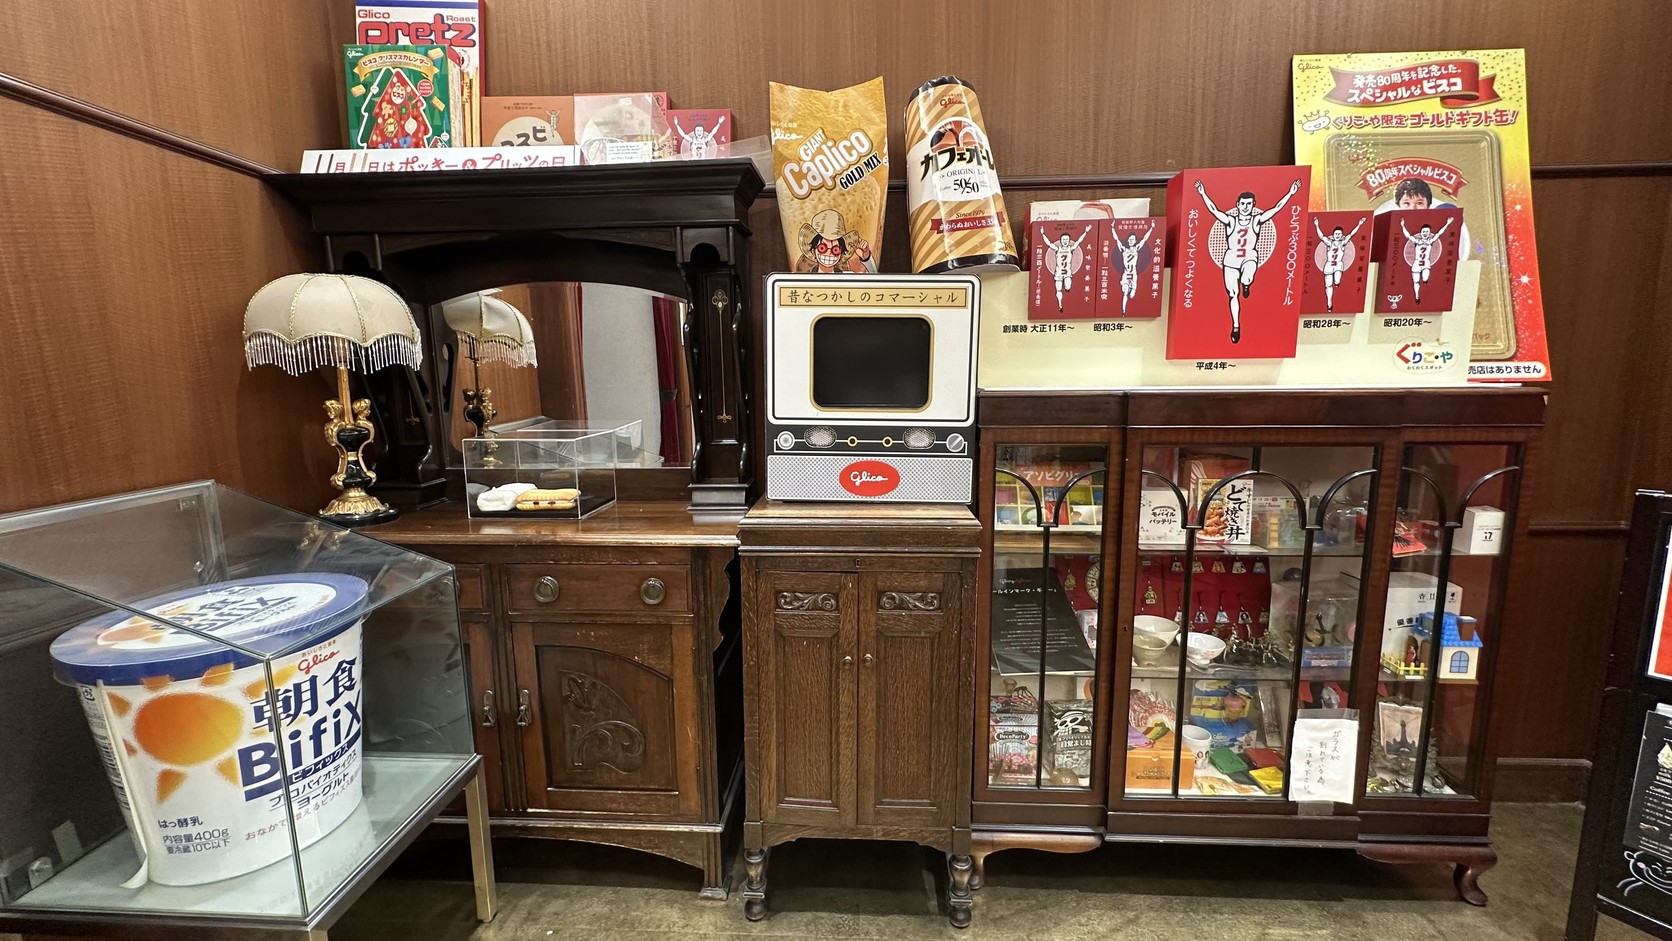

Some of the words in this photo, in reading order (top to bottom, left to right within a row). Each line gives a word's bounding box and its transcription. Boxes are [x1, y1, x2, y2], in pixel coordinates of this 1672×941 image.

[357, 9, 391, 19] Glico
[358, 13, 476, 47] pretz
[1346, 77, 1463, 103] スペシャルなビスコ
[800, 130, 827, 161] GIANT
[784, 131, 870, 196] Caplico
[839, 165, 865, 189] GOLD
[863, 152, 882, 173] MIX
[920, 146, 995, 182] カフェオーレ
[1366, 163, 1458, 188] 80周年スペシャルビスコ
[1236, 226, 1249, 258] グリコ
[1183, 208, 1199, 309] おいしくてつよくなる
[1331, 247, 1339, 266] グリコ
[1418, 246, 1427, 267] グリコ
[788, 289, 959, 304] 昔なつかしのコマーシャル
[1003, 324, 1028, 333] 創業時
[1467, 364, 1542, 375] 売店はありません
[850, 471, 889, 486] Glico
[1023, 470, 1080, 482] アソビグリ
[1225, 484, 1247, 541] どて焼き丼
[297, 650, 340, 675] Glico
[250, 656, 358, 733] 朝食
[1330, 730, 1342, 761] ガラスが
[291, 744, 349, 783] ビフィックス
[297, 771, 350, 810] ヨーグルト
[157, 815, 204, 829] はっ酵乳
[162, 828, 230, 844] 内容量400g
